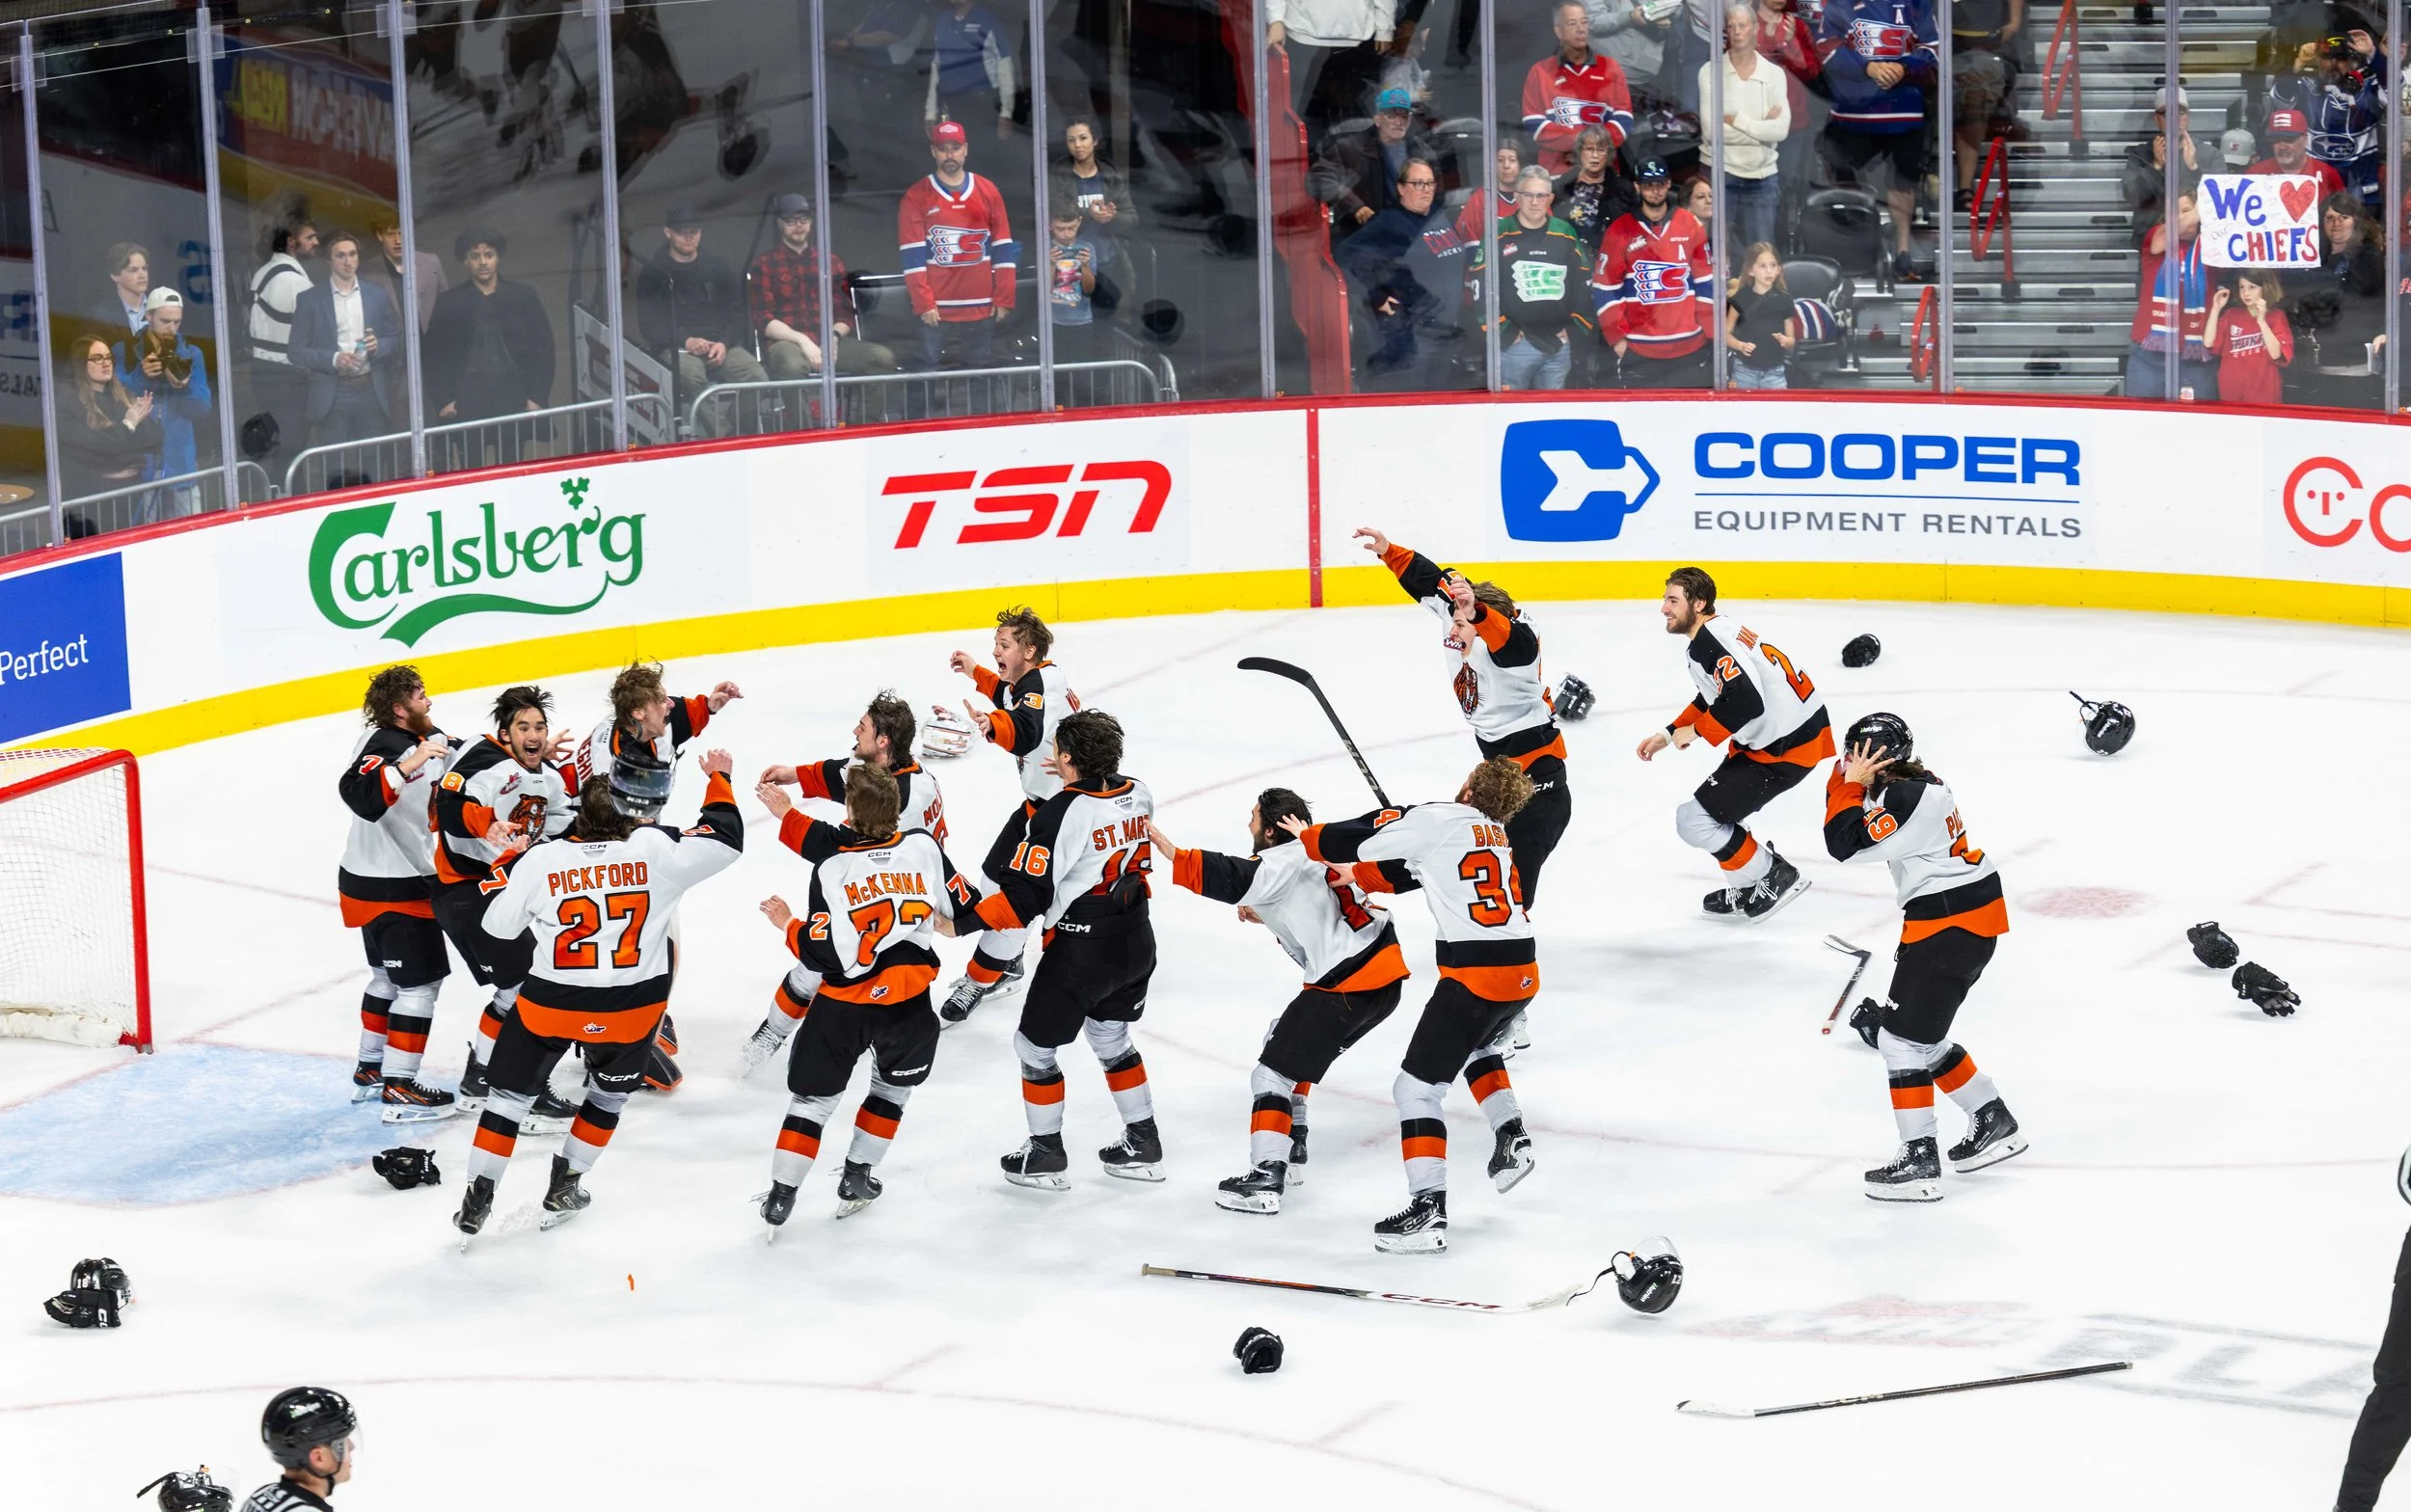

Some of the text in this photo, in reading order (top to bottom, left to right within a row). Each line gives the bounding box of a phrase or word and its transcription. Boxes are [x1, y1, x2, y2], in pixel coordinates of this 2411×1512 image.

[2204, 177, 2266, 227] We
[2228, 225, 2319, 262] CHIEFS
[1694, 432, 2080, 486] COOPER
[881, 460, 1172, 549] TSN
[1694, 511, 2081, 538] EQUIPMENT RENTALS
[309, 501, 646, 630] Carlsberg
[0, 634, 89, 686] Perfect
[359, 754, 385, 776] 7
[1114, 796, 1133, 805] CCM
[582, 843, 608, 851] CCM
[1010, 841, 1051, 878] 16
[546, 861, 649, 897] PICKFORD
[844, 872, 928, 906] McKENNA
[553, 889, 651, 970] 27
[1057, 921, 1092, 933] CCM
[598, 1071, 640, 1082] CCM
[388, 1088, 410, 1104] CCM
[1403, 1207, 1436, 1231] CCM
[77, 1278, 89, 1289] 18
[1380, 1293, 1503, 1310] CCM
